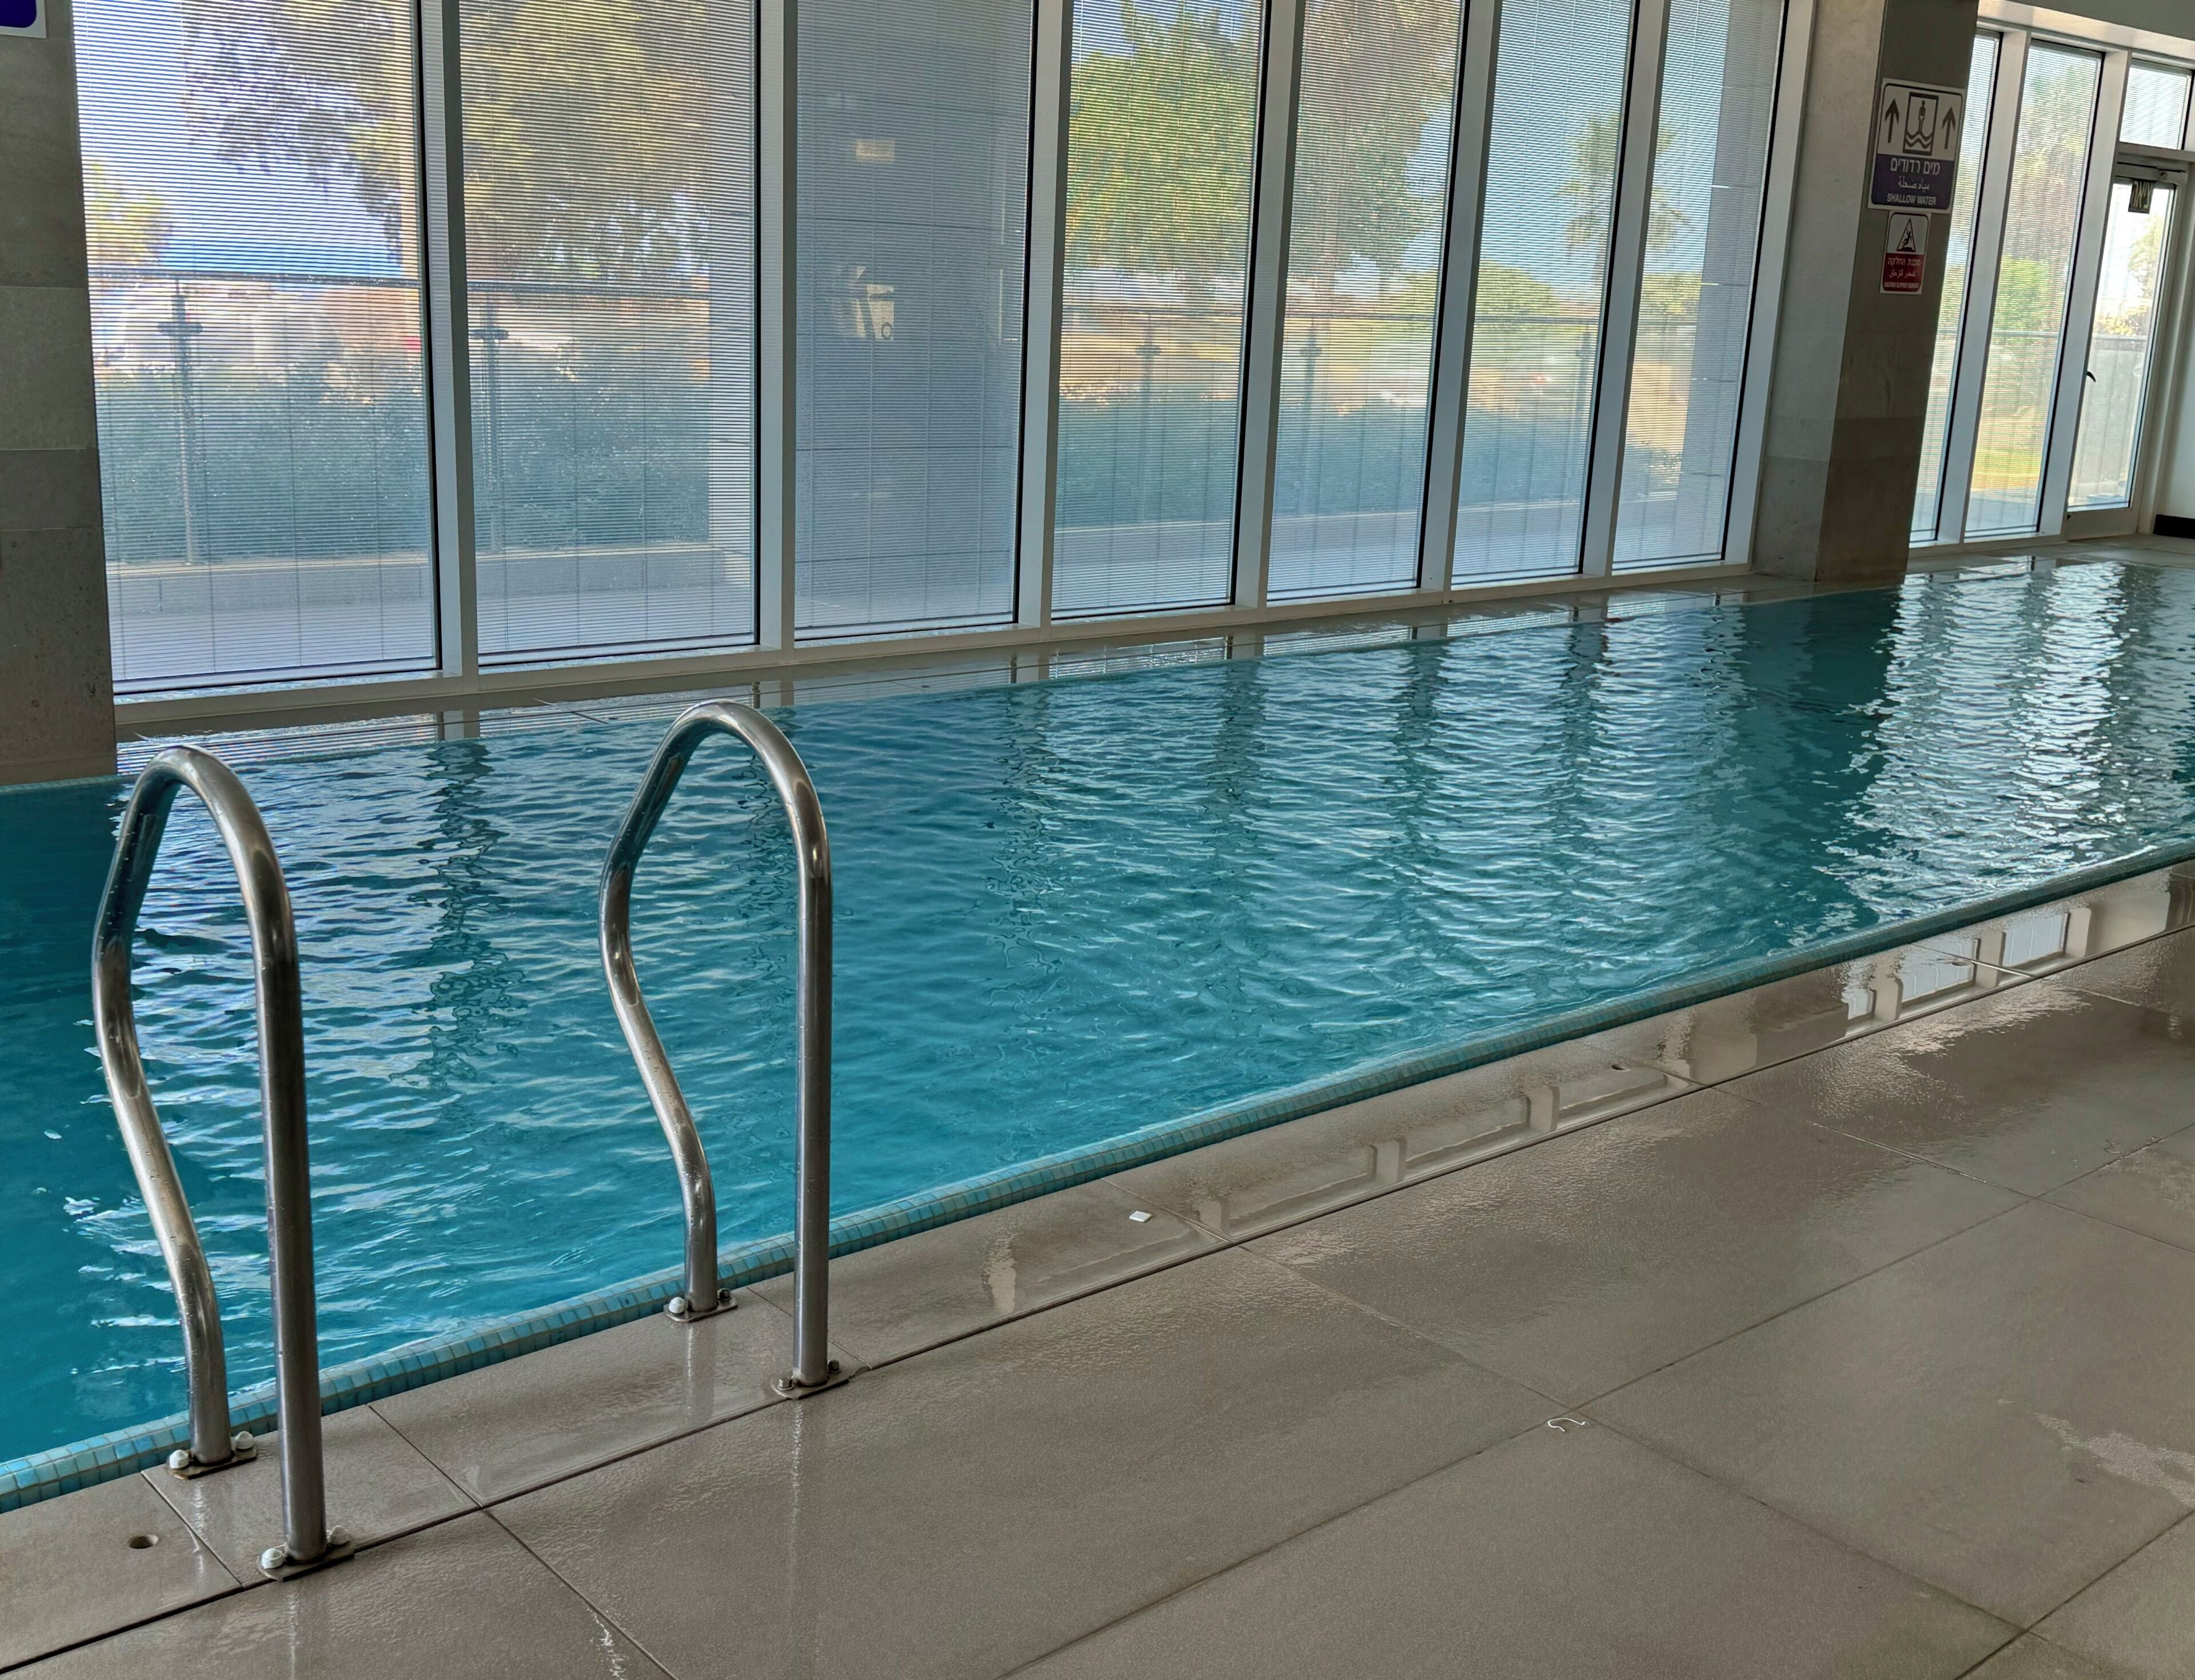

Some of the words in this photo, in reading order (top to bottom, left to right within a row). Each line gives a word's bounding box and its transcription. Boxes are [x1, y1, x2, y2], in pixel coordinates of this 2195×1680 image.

[1890, 158, 1921, 173] רדודים
[1923, 161, 1940, 175] מים
[1887, 193, 1916, 203] SHALLOW
[1917, 195, 1937, 205] WATER
[1887, 256, 1906, 267] החלקה
[1907, 258, 1921, 266] סכנת
